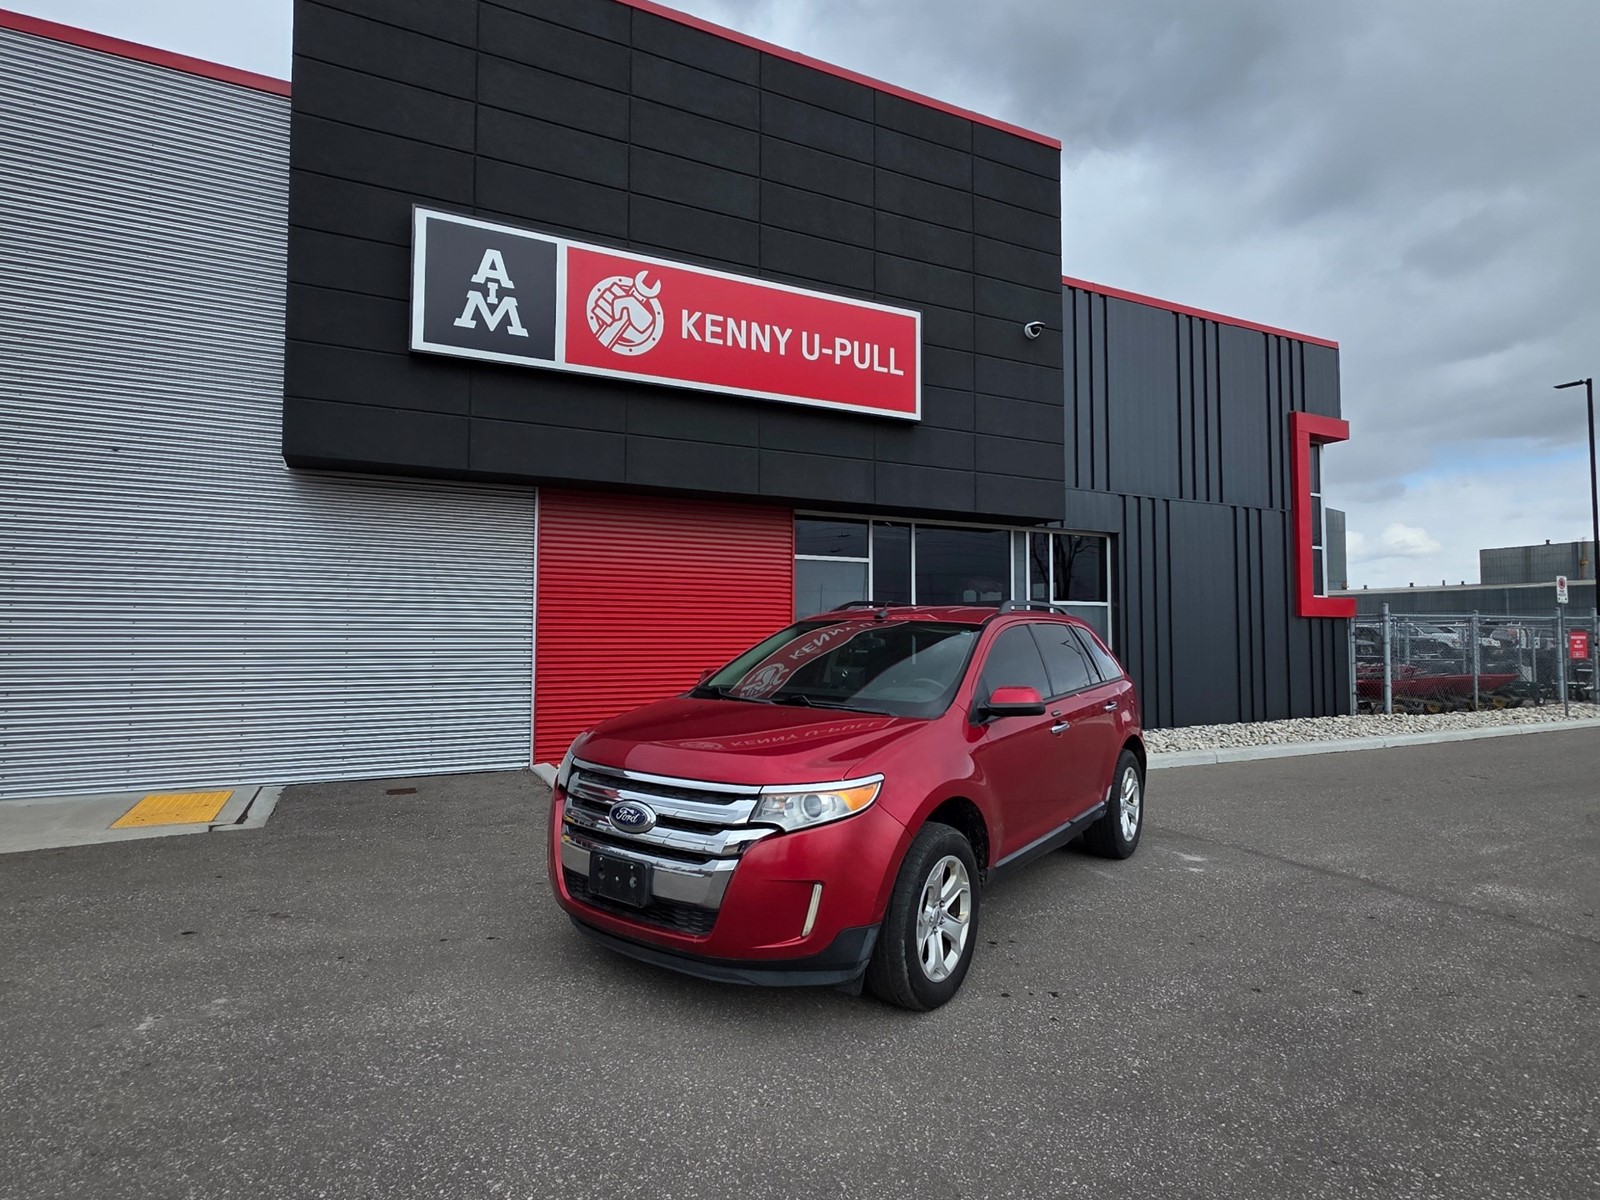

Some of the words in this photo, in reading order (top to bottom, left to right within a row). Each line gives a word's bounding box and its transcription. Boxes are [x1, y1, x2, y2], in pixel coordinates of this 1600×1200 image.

[681, 308, 793, 356] KENNY
[801, 330, 905, 376] U-PULL
[615, 806, 641, 824] Ford
